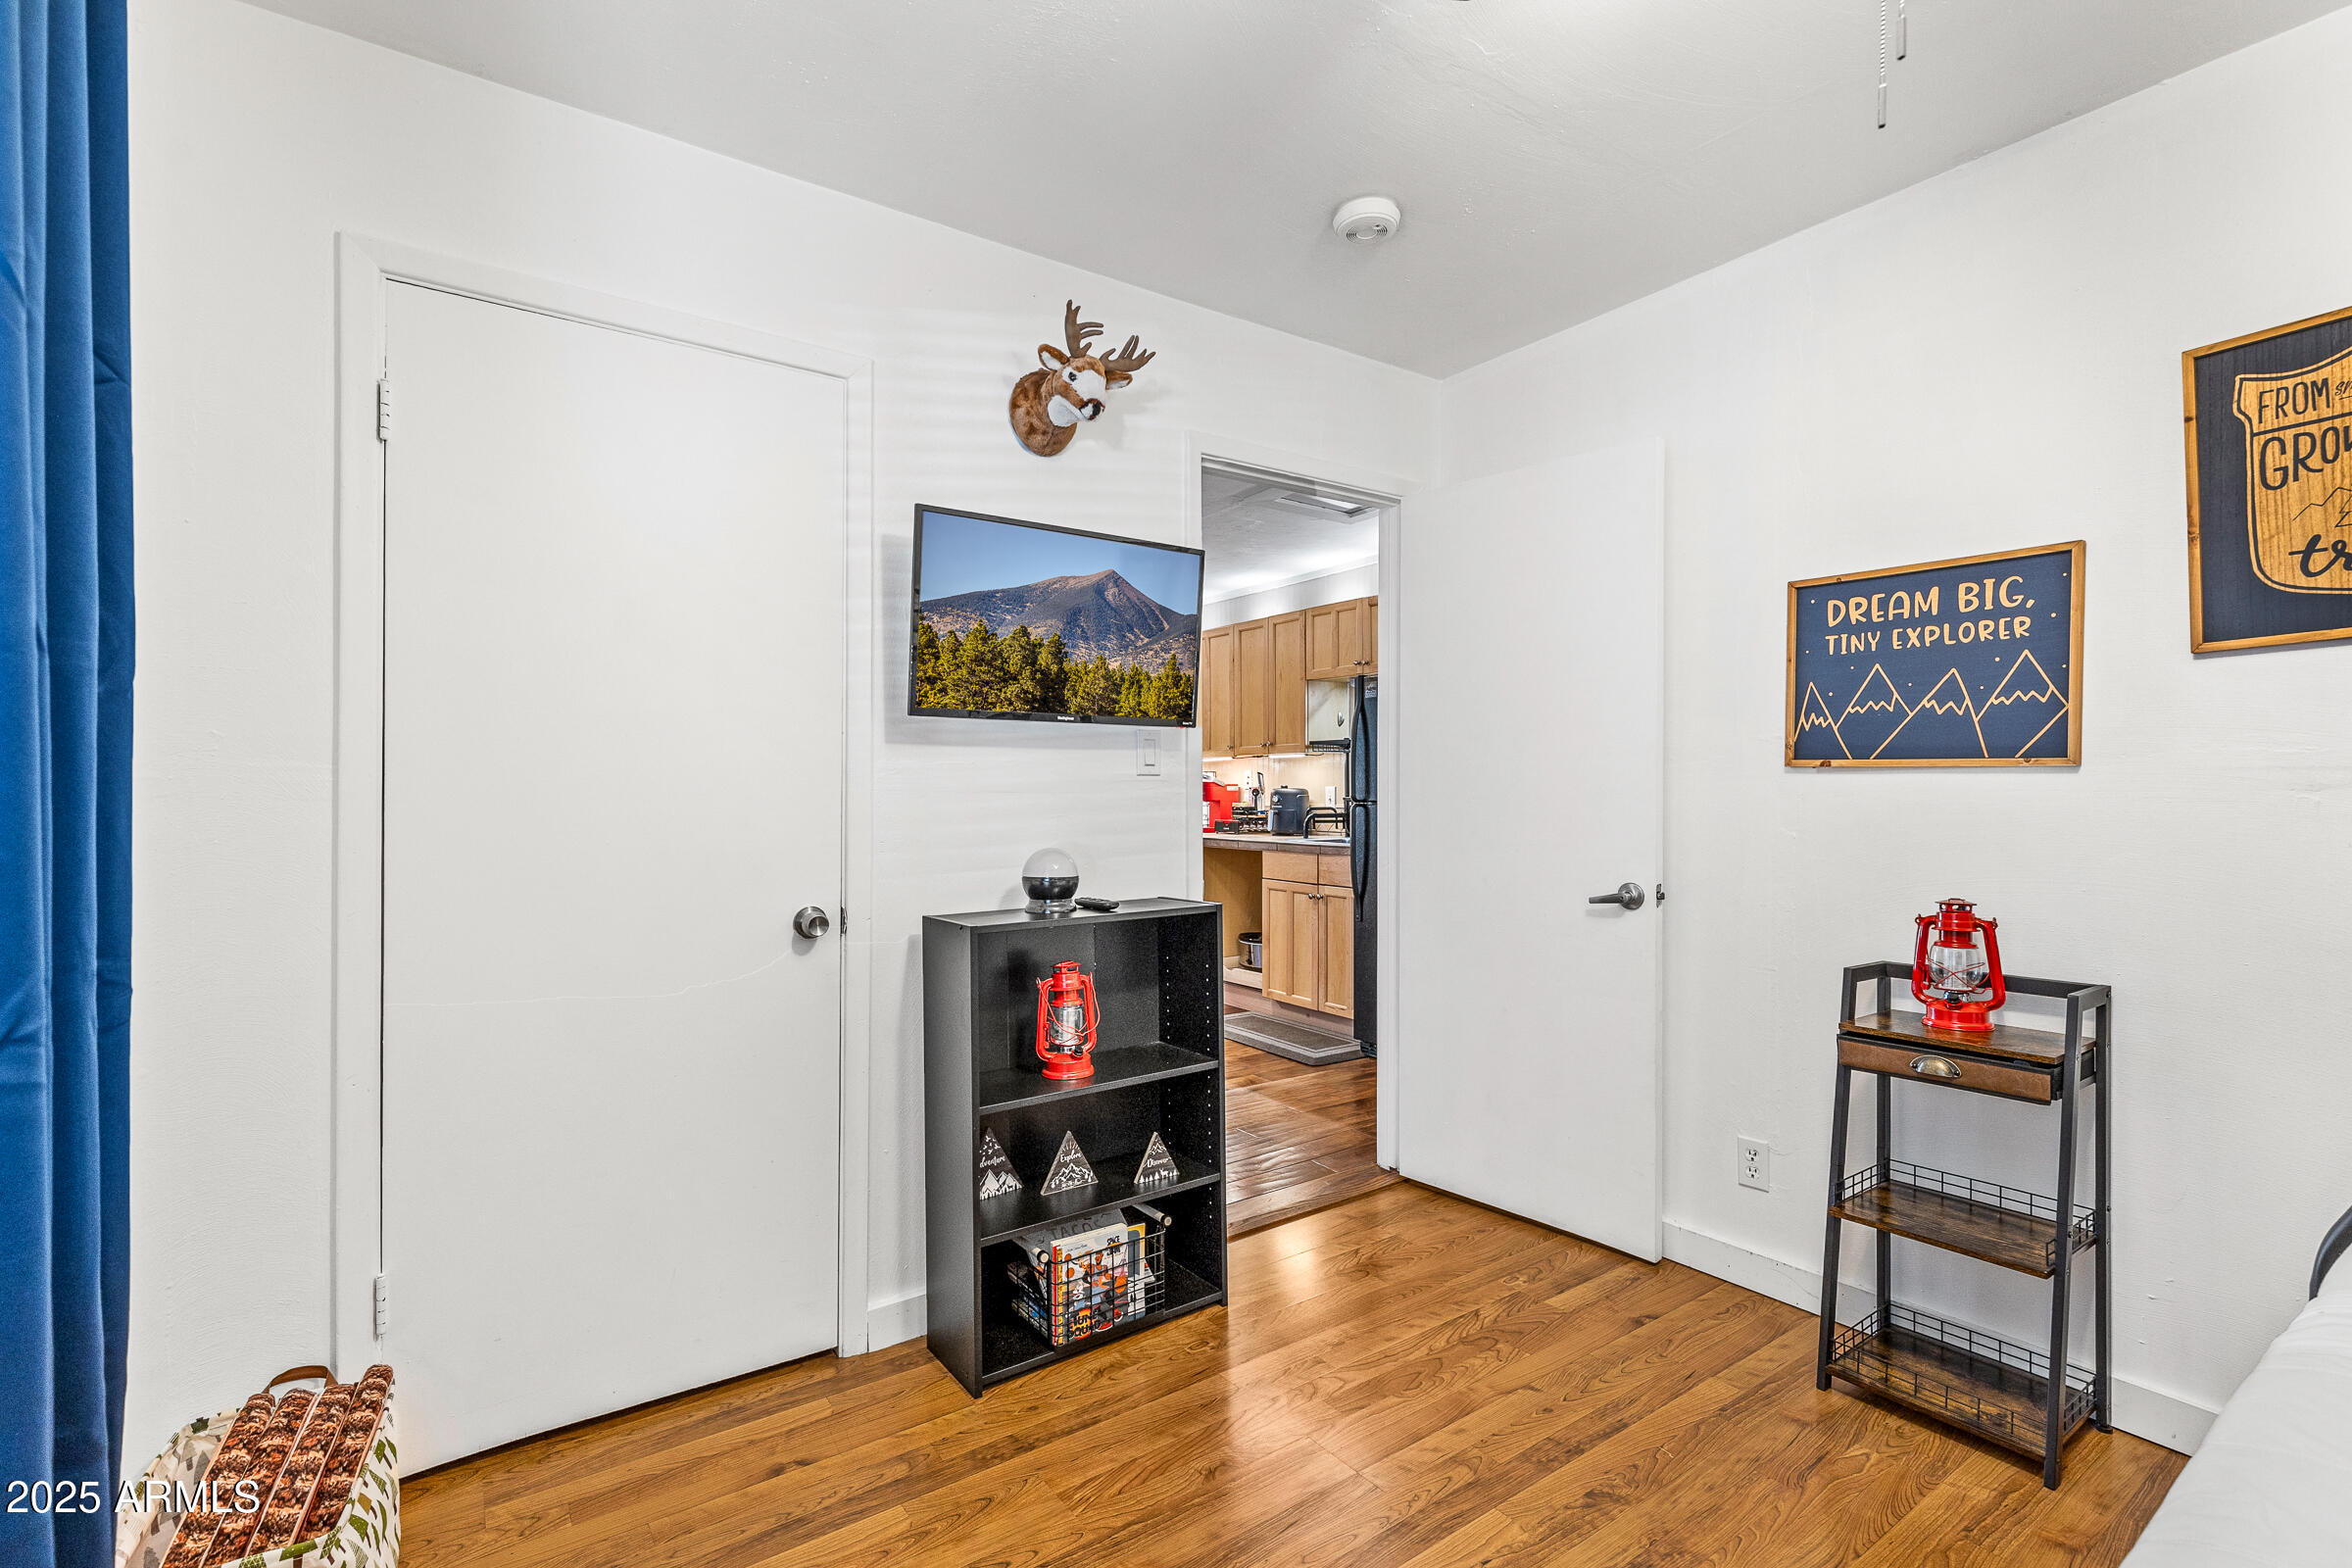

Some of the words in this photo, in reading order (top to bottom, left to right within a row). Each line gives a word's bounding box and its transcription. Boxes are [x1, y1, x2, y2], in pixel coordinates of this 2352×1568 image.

[2258, 377, 2330, 424] FROM
[2288, 534, 2352, 578] tr
[1827, 586, 1939, 627] DREAM
[1957, 575, 2035, 612] BIG,
[1825, 630, 1881, 656] TINY
[1892, 615, 2032, 650] EXPLORER
[979, 1156, 1006, 1168] dventure
[1059, 1149, 1082, 1163] Explore
